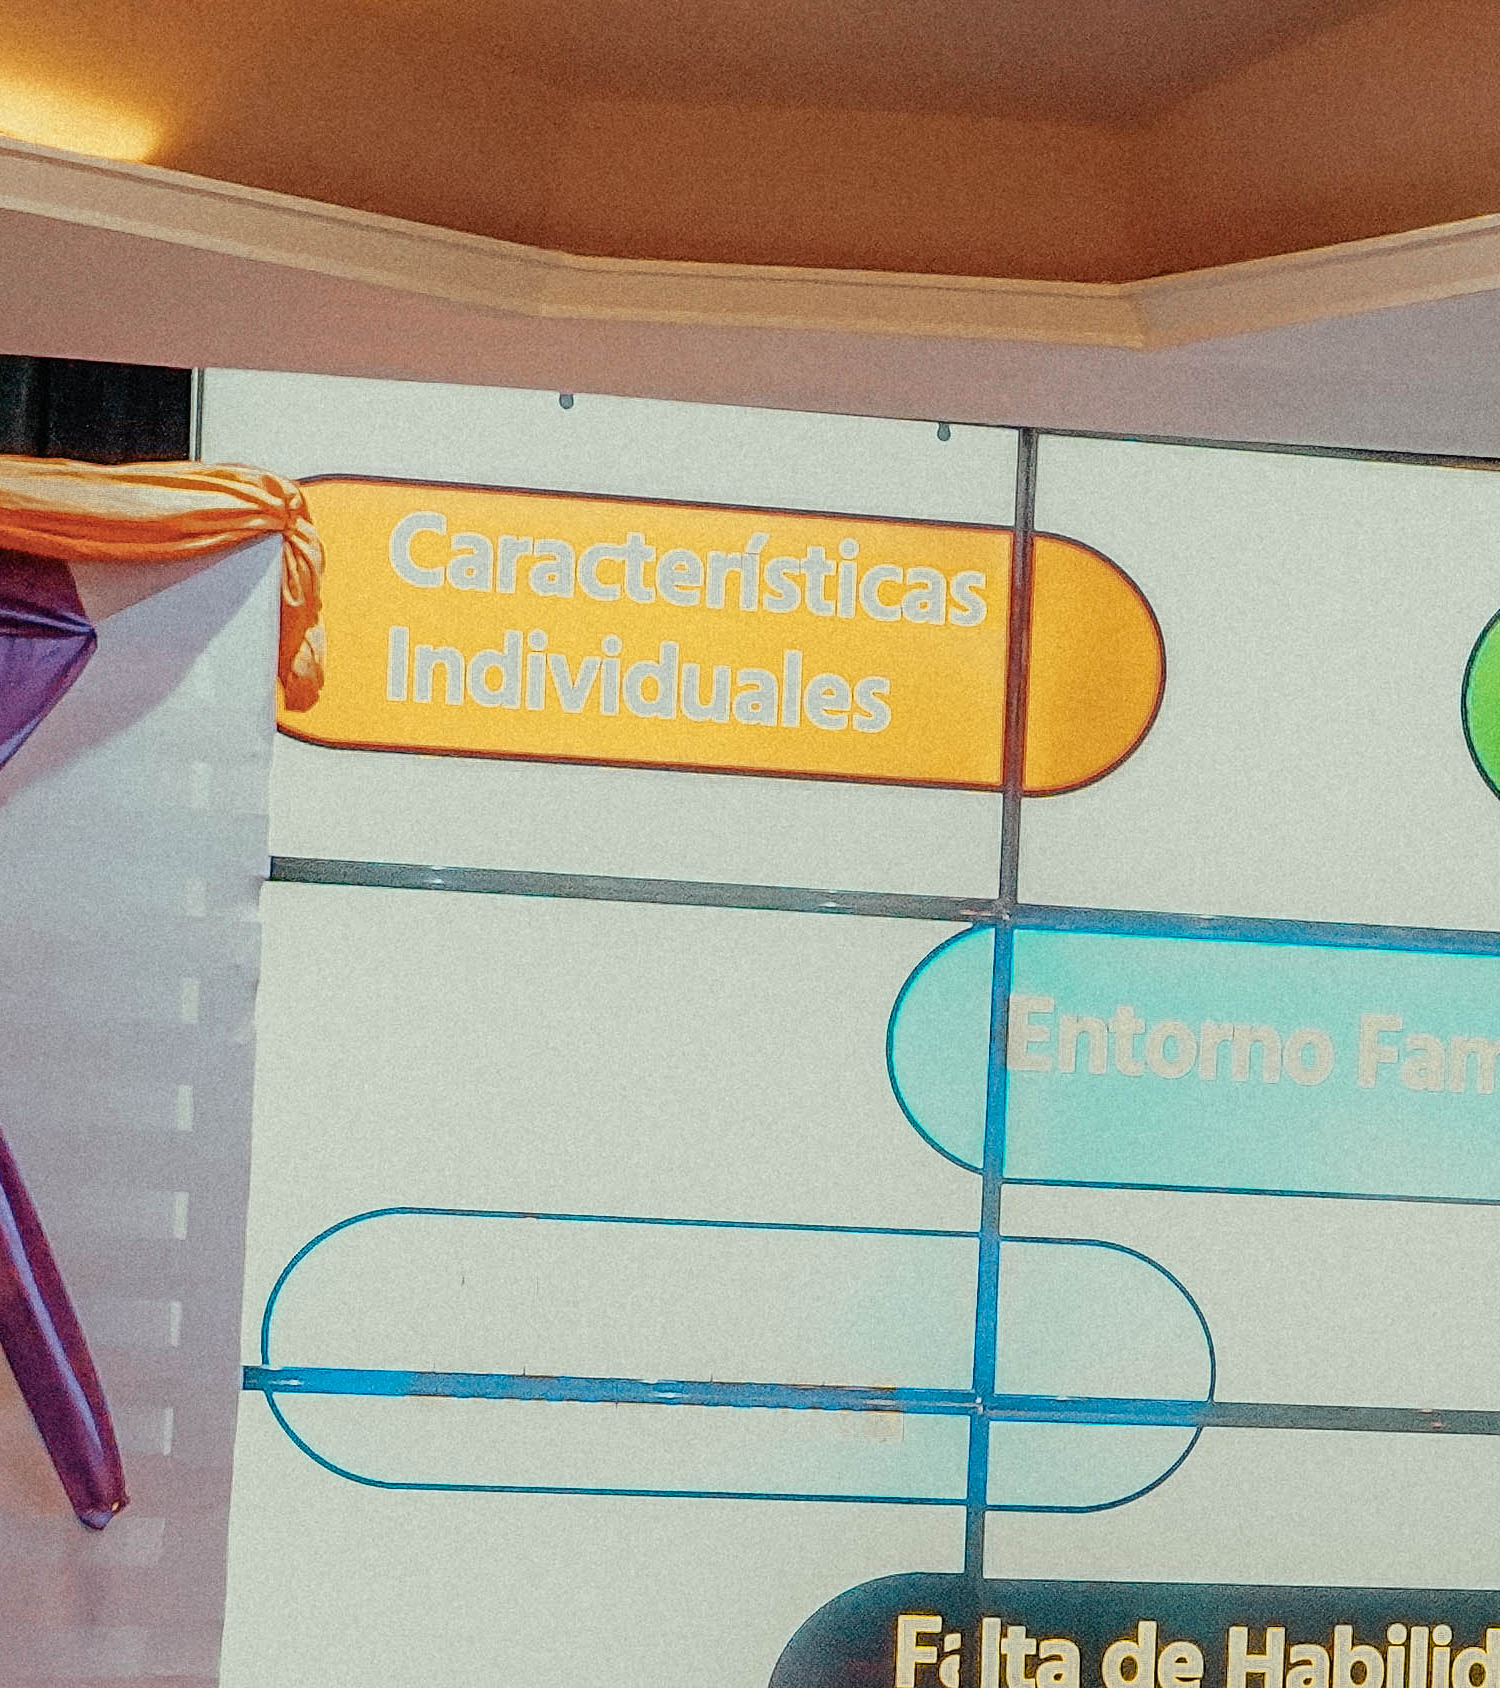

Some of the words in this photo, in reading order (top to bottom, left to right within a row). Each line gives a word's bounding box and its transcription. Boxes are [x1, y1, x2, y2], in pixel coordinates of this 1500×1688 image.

[389, 511, 987, 627] Características
[385, 627, 892, 734] Individuales
[1006, 995, 1333, 1086] Entorno
